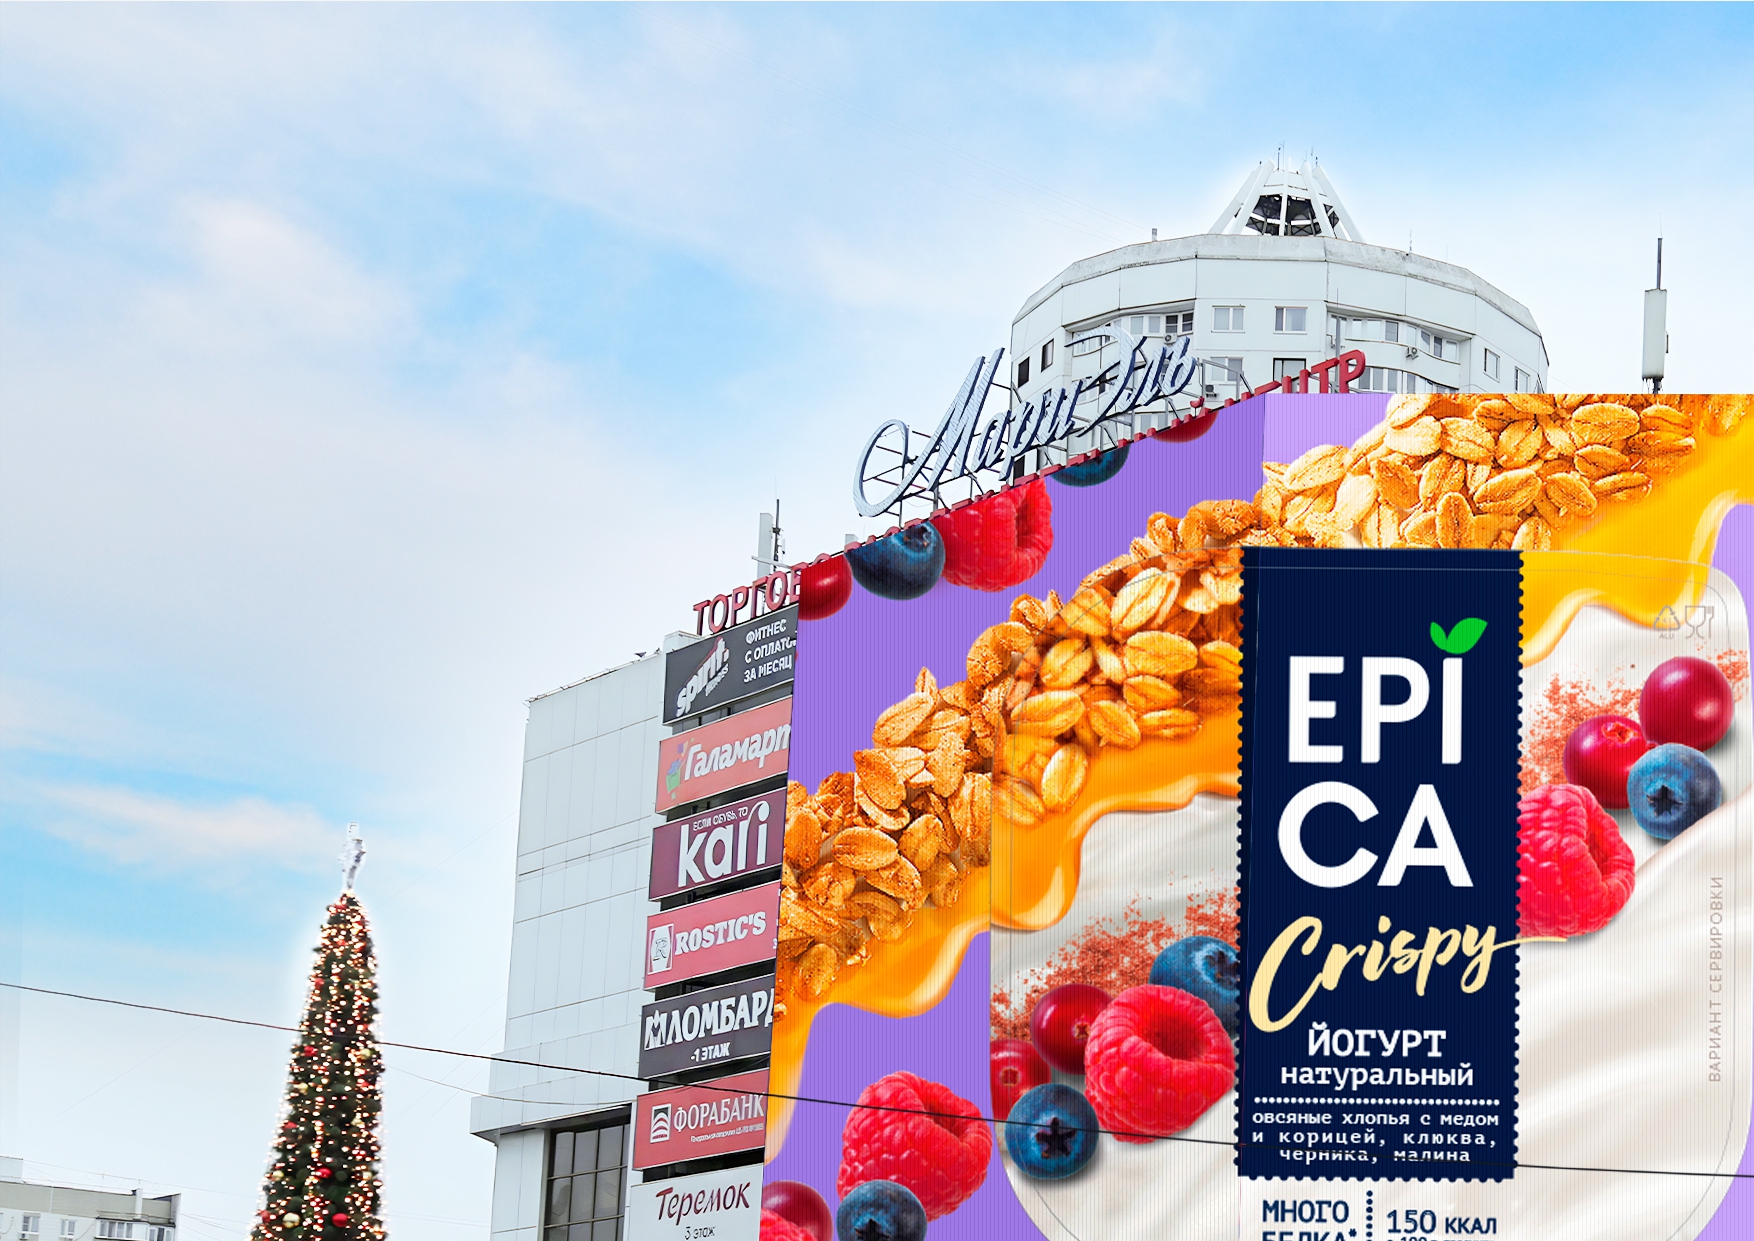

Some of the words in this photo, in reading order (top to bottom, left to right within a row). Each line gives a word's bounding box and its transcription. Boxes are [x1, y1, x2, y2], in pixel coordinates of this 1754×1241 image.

[746, 619, 787, 645] ФИТНЕС
[758, 655, 793, 678] МЕСЯЦ
[678, 800, 770, 888] kari
[1278, 781, 1474, 888] CA
[675, 911, 766, 955] ROSTIC'S
[1710, 876, 1723, 993] СЕРВИРОВКИ
[1249, 915, 1567, 1032] Crispy
[701, 1042, 731, 1061] ЭТАЖ
[1308, 1021, 1446, 1057] ЙОГУРТ
[1709, 1000, 1722, 1082] ВАРИАНТ
[1281, 1062, 1474, 1091] натуральный
[674, 1092, 764, 1133] ФОРАБАНК
[1252, 1111, 1332, 1125] овсяные
[1342, 1112, 1410, 1125] хлопья
[1420, 1113, 1430, 1125] с
[1440, 1113, 1499, 1127] медом
[1252, 1132, 1264, 1143] и
[1279, 1129, 1386, 1147] корицей,
[1403, 1132, 1497, 1149] клюква,
[1279, 1149, 1378, 1165] черника,
[1393, 1150, 1471, 1163] малина
[656, 1182, 751, 1226] Теремок
[1262, 1199, 1350, 1223] МНОГО
[1387, 1209, 1437, 1234] 150
[1445, 1217, 1497, 1235] ККАЛ
